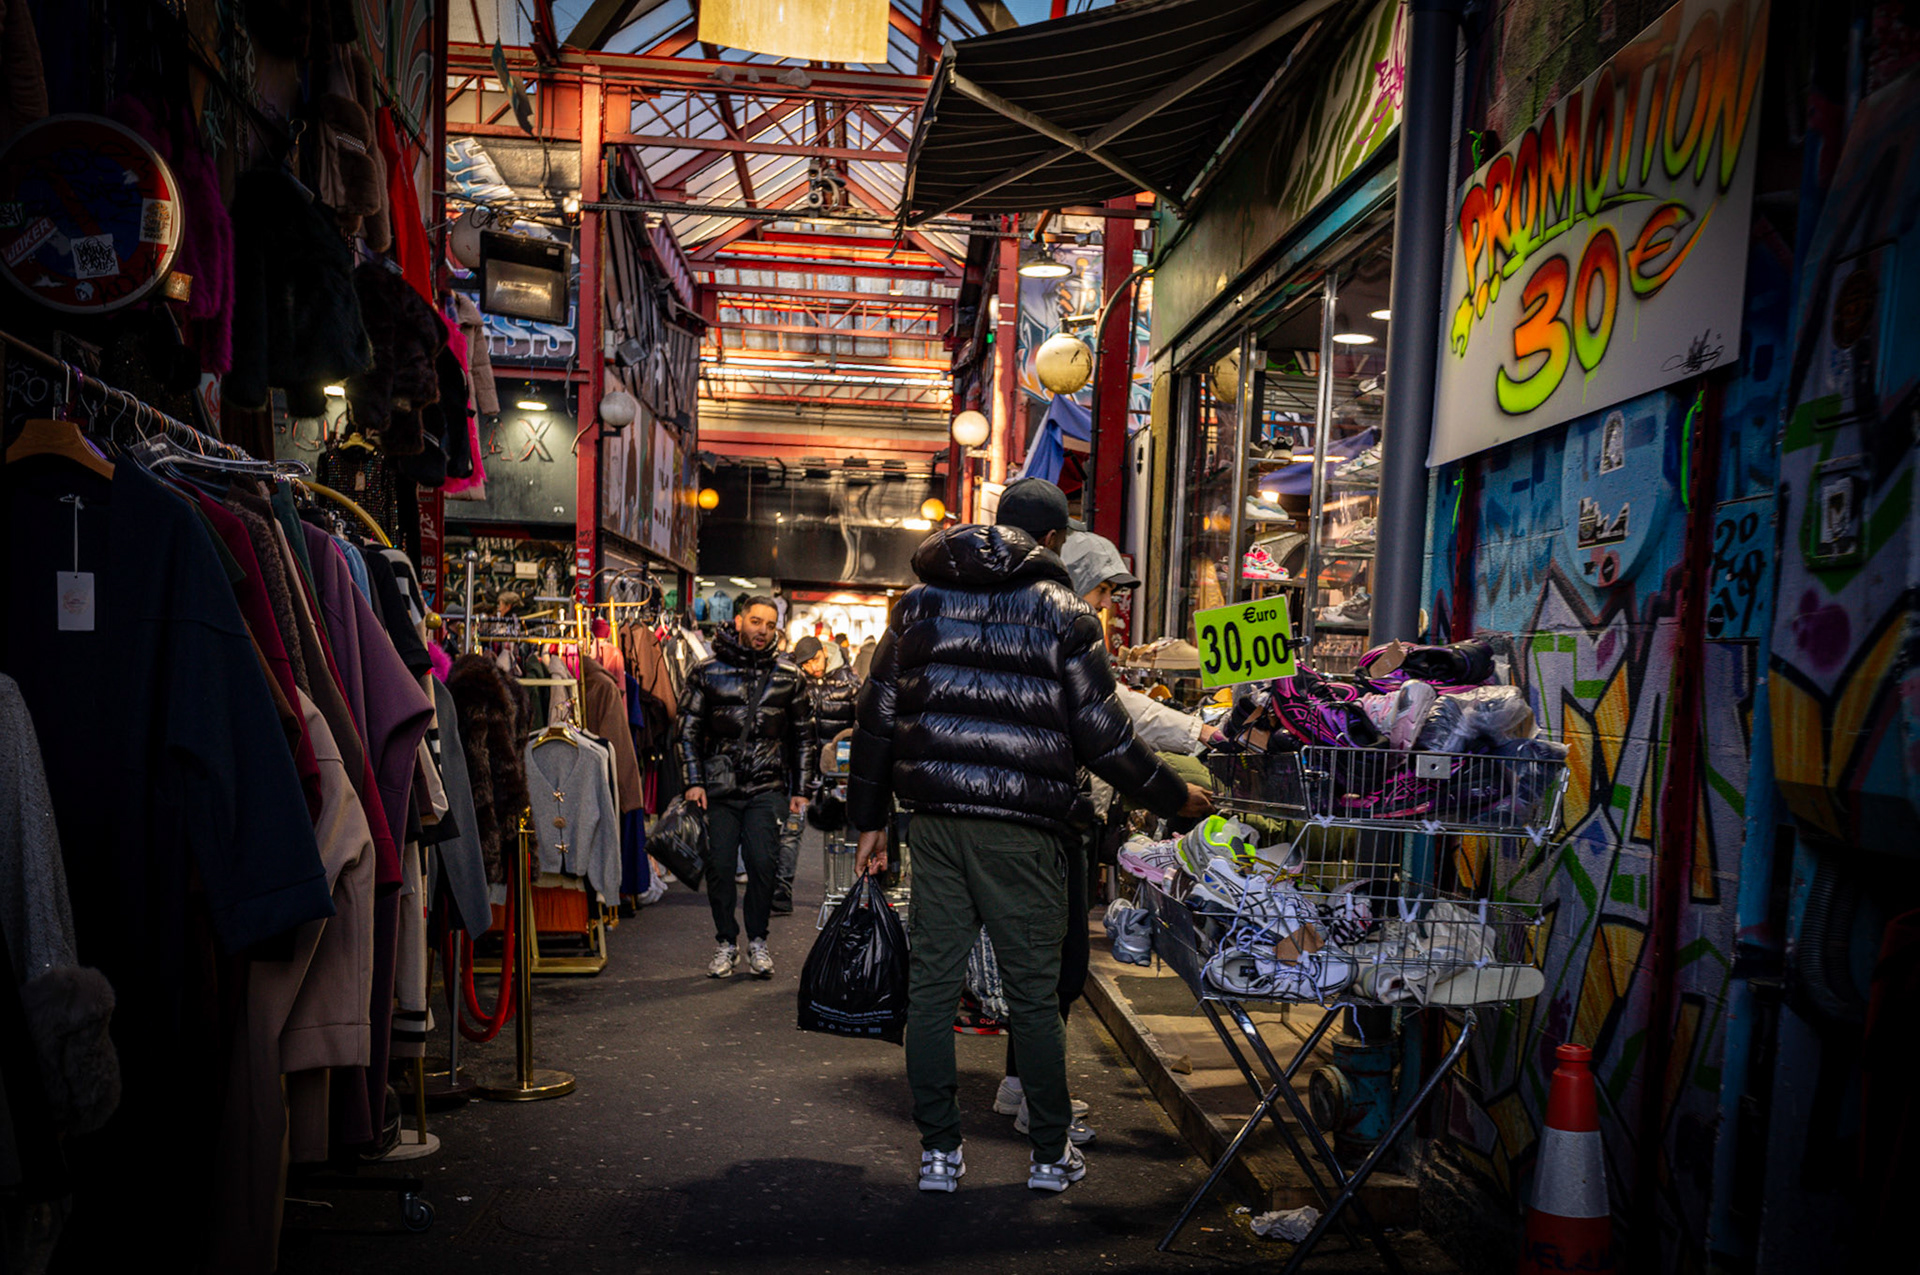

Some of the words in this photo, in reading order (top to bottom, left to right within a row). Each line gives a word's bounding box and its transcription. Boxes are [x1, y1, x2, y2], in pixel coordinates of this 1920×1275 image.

[1458, 0, 1769, 296] PROMOTION
[7, 217, 51, 261] JOKER
[1242, 606, 1277, 623] €uro
[1202, 622, 1290, 676] 30,00
